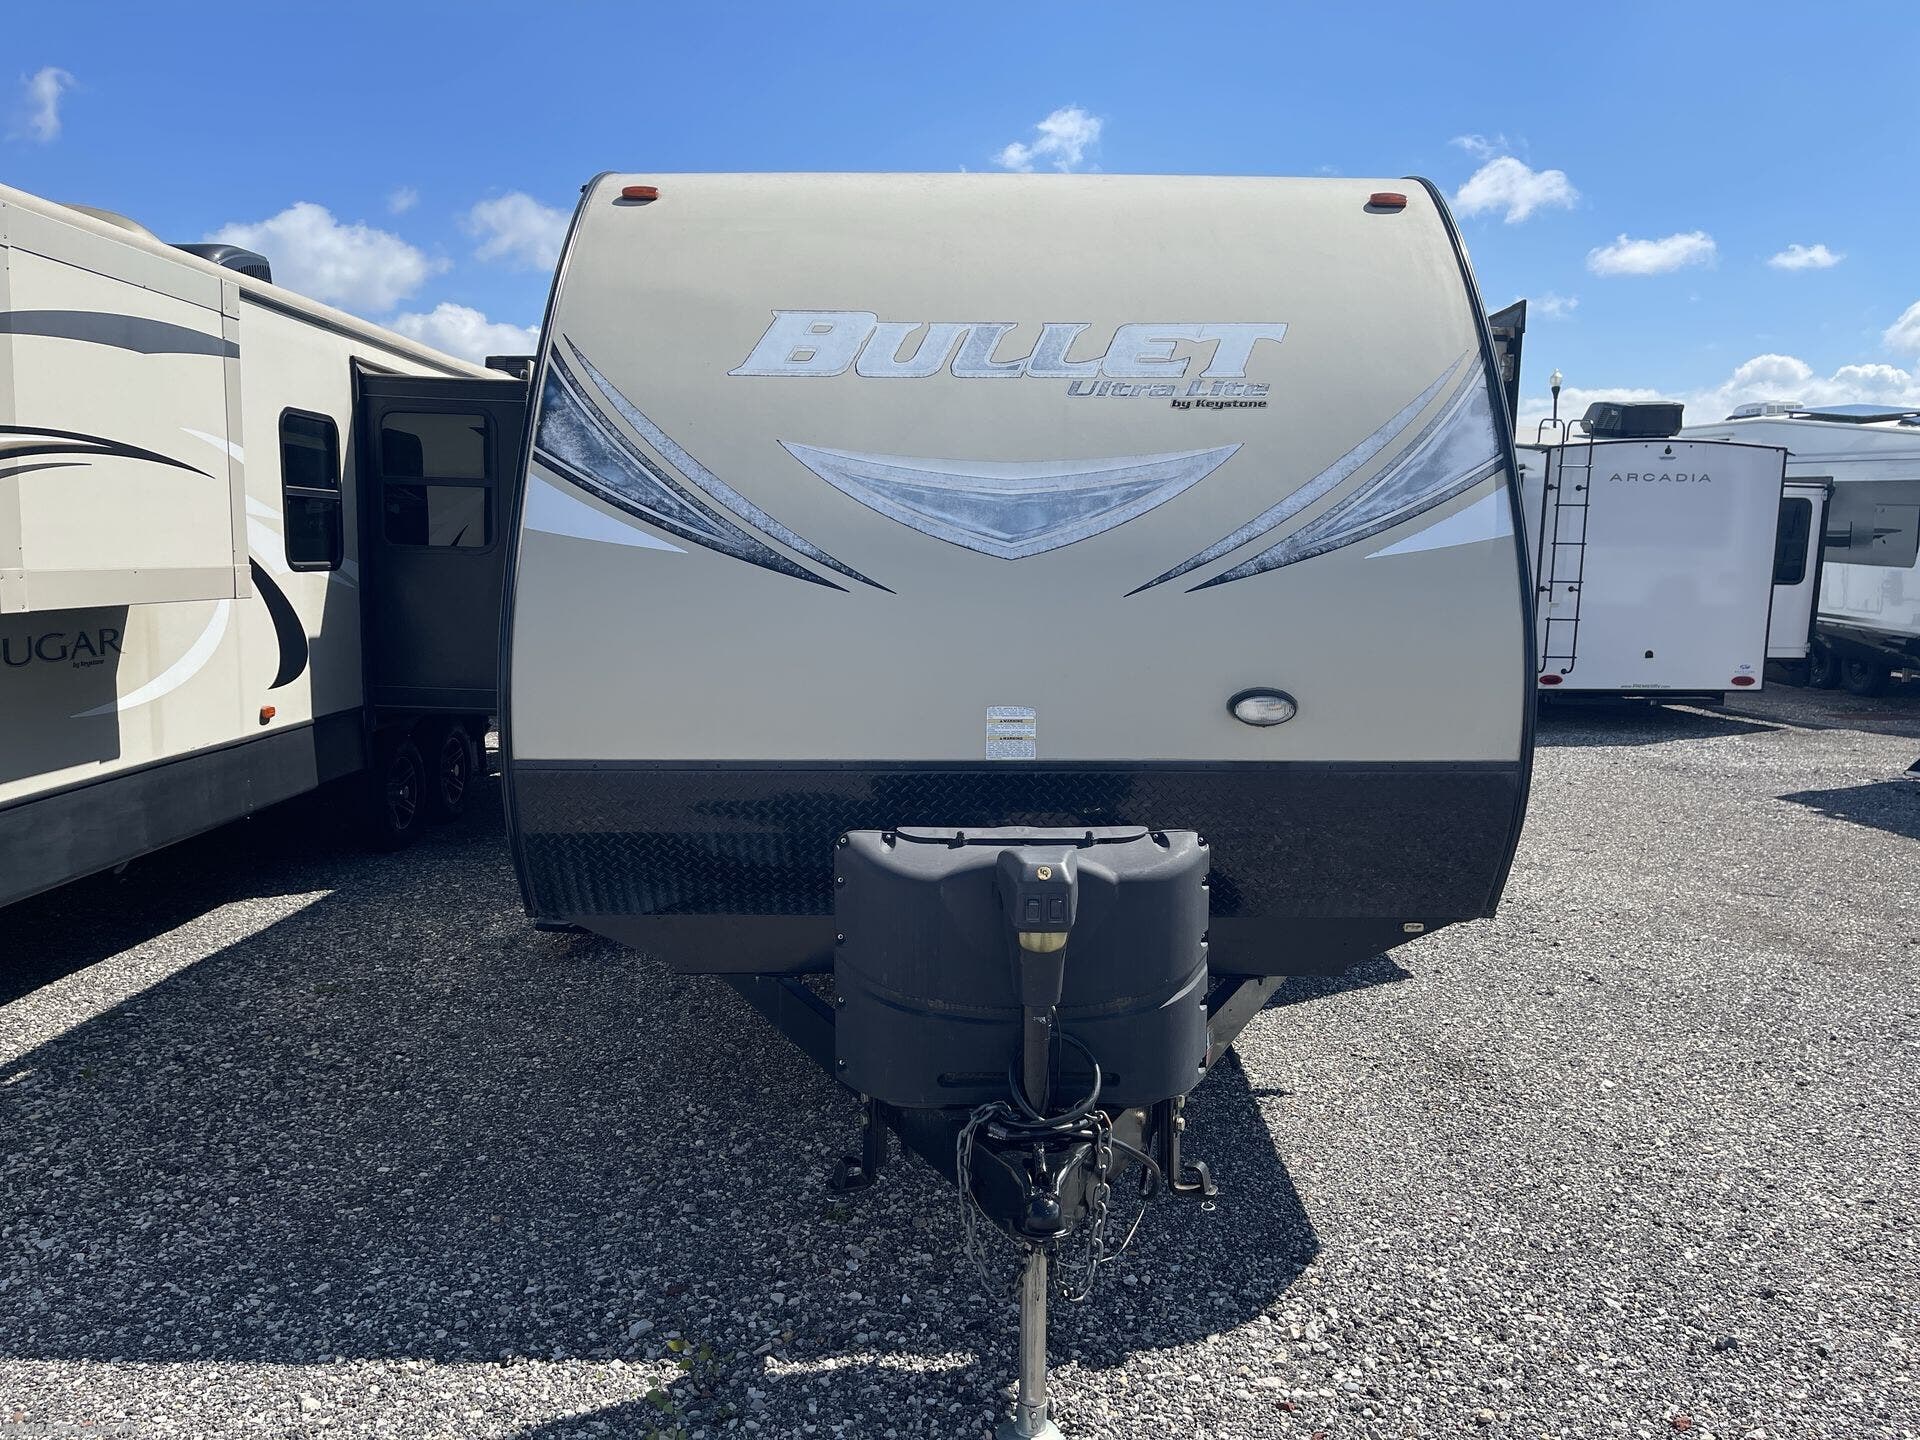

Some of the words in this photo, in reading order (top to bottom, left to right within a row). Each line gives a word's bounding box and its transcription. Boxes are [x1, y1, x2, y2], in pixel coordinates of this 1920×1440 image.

[727, 310, 1289, 378] BULLET
[1067, 380, 1176, 397] Ultra
[1185, 380, 1271, 397] Lite
[1171, 399, 1191, 410] by
[1195, 399, 1268, 410] Keystone
[1609, 472, 1712, 483] ARCADIA
